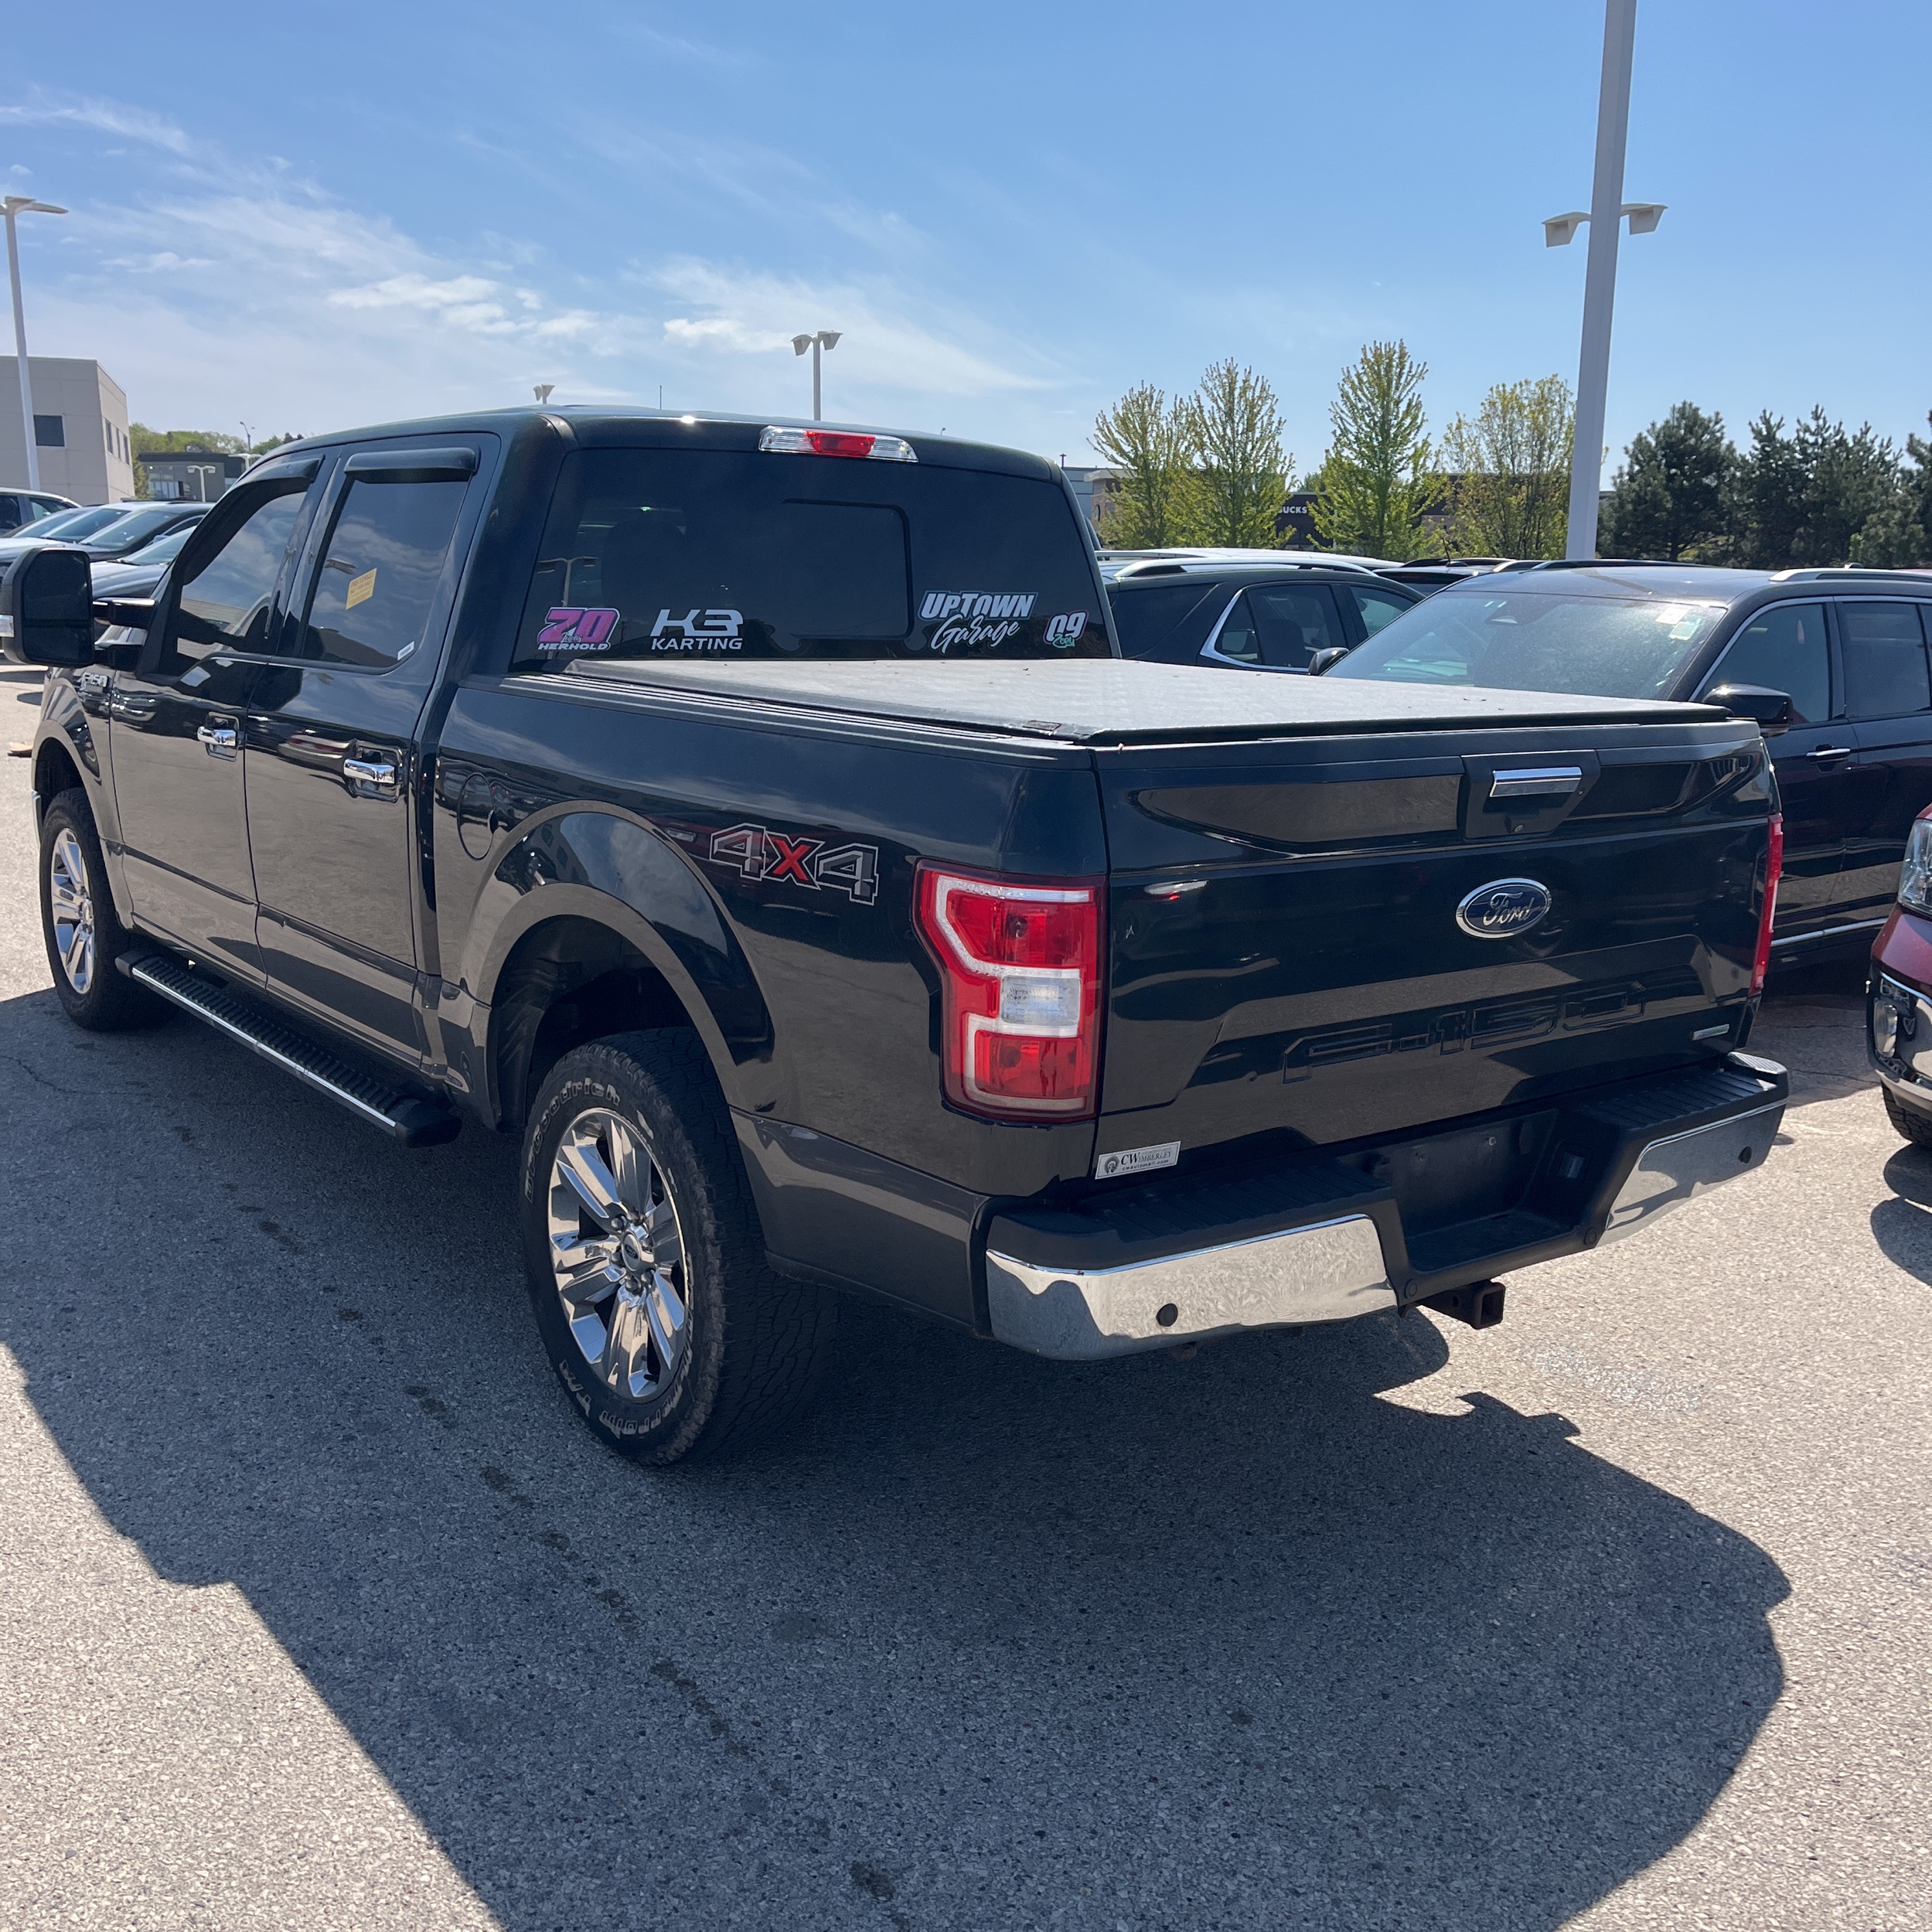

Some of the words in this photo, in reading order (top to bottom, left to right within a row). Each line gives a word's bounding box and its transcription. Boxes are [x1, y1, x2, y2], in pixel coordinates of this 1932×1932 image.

[921, 593, 1035, 618] UPTOWN
[538, 608, 619, 642] 70
[650, 609, 743, 636] K3
[930, 614, 1021, 654] Garage
[1046, 612, 1086, 642] 09
[651, 638, 743, 650] KARTING
